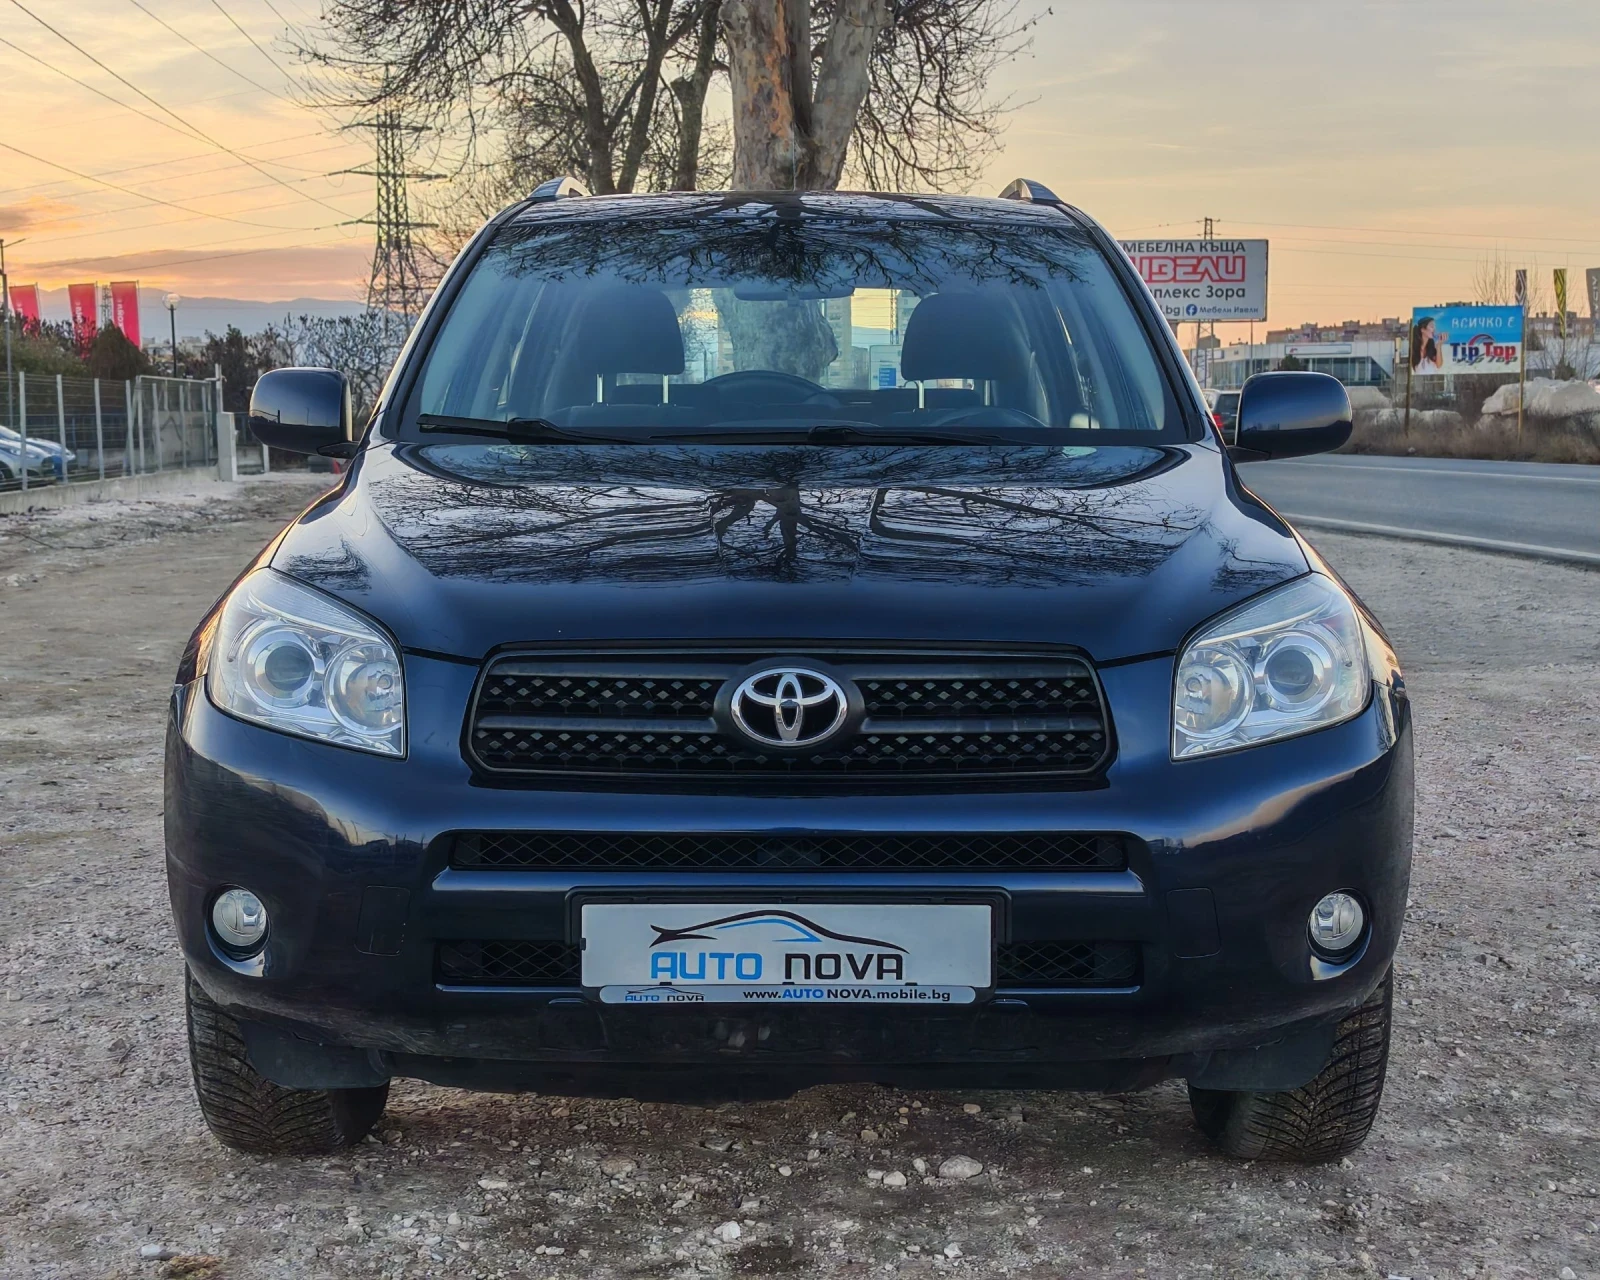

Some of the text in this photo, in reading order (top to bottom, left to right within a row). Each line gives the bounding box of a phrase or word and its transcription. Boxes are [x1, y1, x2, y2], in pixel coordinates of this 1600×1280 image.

[1123, 241, 1246, 254] МЕБЕЛНА КЪЩА
[1150, 285, 1246, 301] плекс Зора
[1199, 305, 1260, 314] Мебели Ивели
[1451, 316, 1503, 329] ВСИЧКО
[1450, 341, 1516, 362] Tip Top
[650, 952, 904, 980] AUTO NOVA
[625, 994, 660, 1002] AUTO
